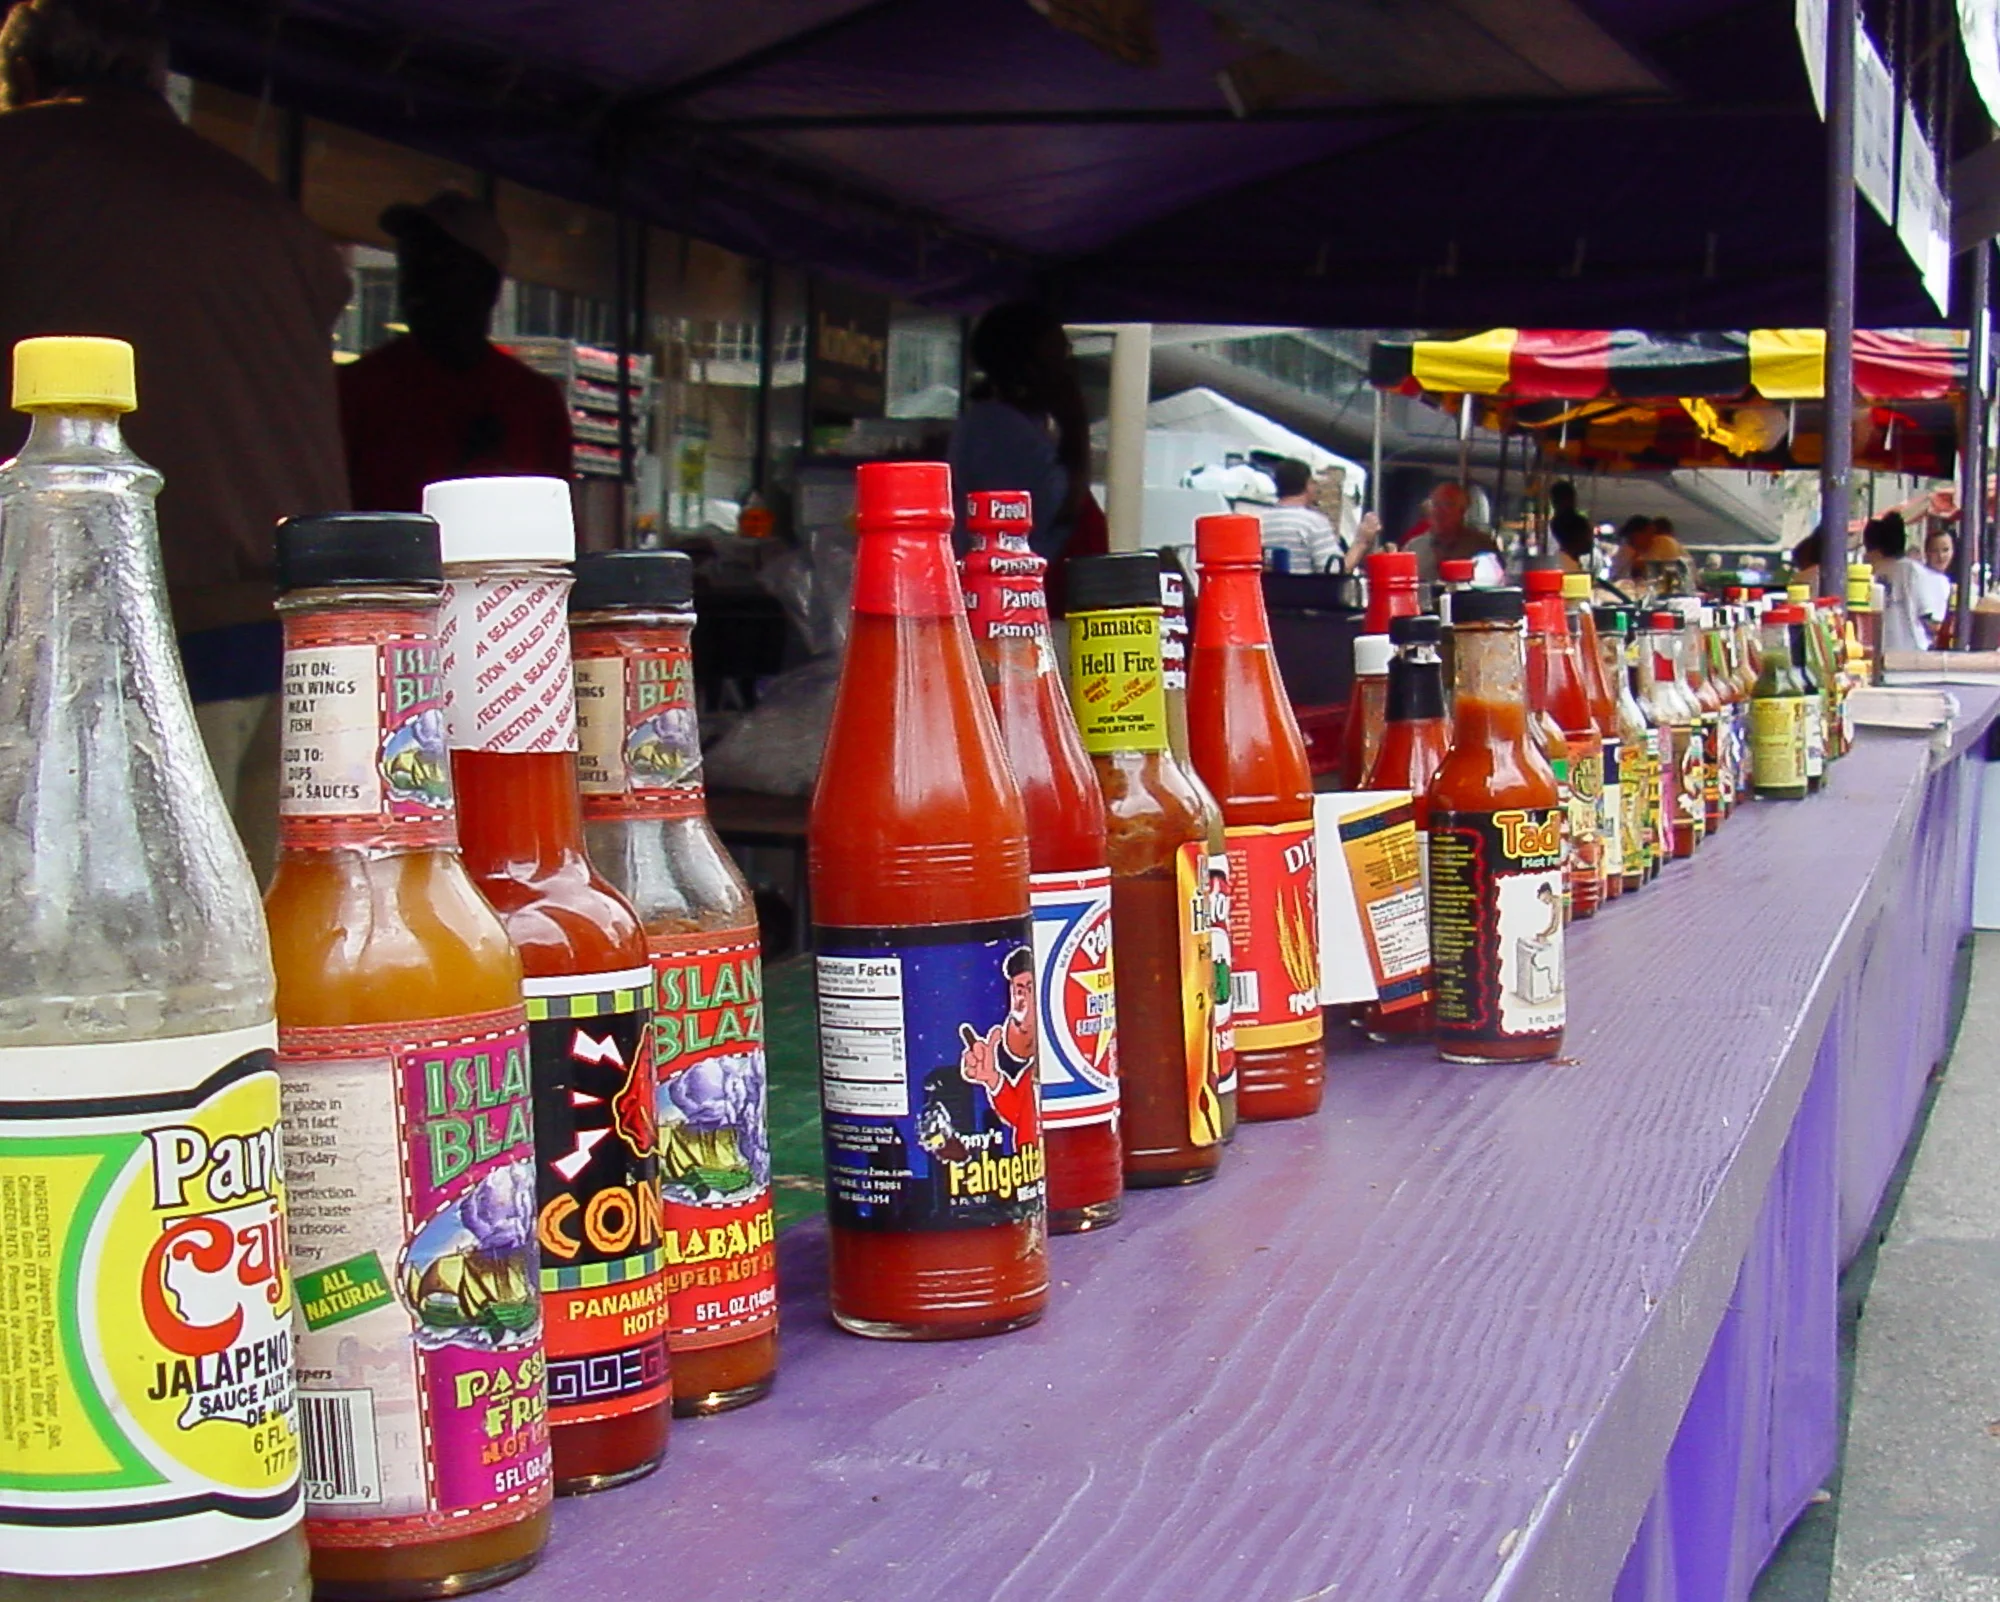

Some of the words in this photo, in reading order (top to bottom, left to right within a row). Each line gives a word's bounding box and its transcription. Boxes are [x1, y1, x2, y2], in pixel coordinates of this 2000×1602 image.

[1080, 615, 1153, 641] Jamaica
[1081, 652, 1116, 676] Hell
[1123, 650, 1157, 673] Fire
[308, 681, 356, 695] WINGS
[290, 719, 312, 733] FISH
[306, 784, 360, 799] SAUCES
[858, 963, 898, 977] Facts
[321, 1268, 354, 1295] ALL
[305, 1279, 386, 1321] NATURAL
[569, 1281, 664, 1320] PANAMA'S
[696, 1303, 706, 1321] 5
[623, 1309, 655, 1336] HOT
[199, 1383, 258, 1416] SAUCE
[246, 1405, 267, 1428] DE
[254, 1432, 264, 1453] 6
[264, 1447, 285, 1476] 177
